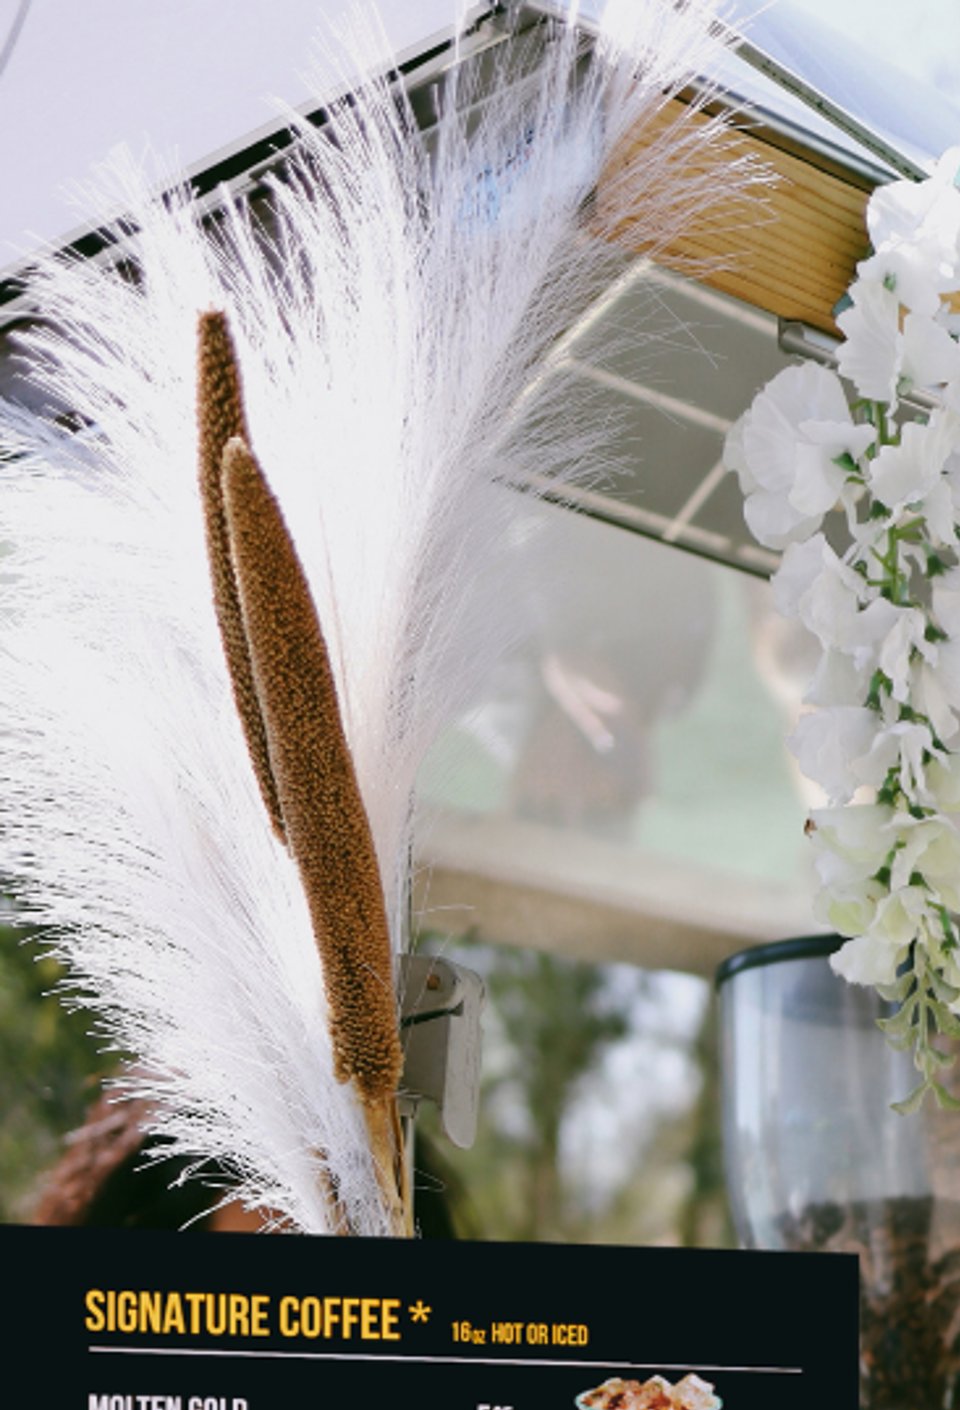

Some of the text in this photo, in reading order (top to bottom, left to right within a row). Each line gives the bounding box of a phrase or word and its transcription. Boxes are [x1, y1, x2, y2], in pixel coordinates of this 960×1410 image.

[85, 1290, 400, 1340] SIGNATURE COFFEE
[492, 1323, 523, 1344] HOT
[526, 1323, 548, 1344] OR
[552, 1324, 588, 1345] ICED
